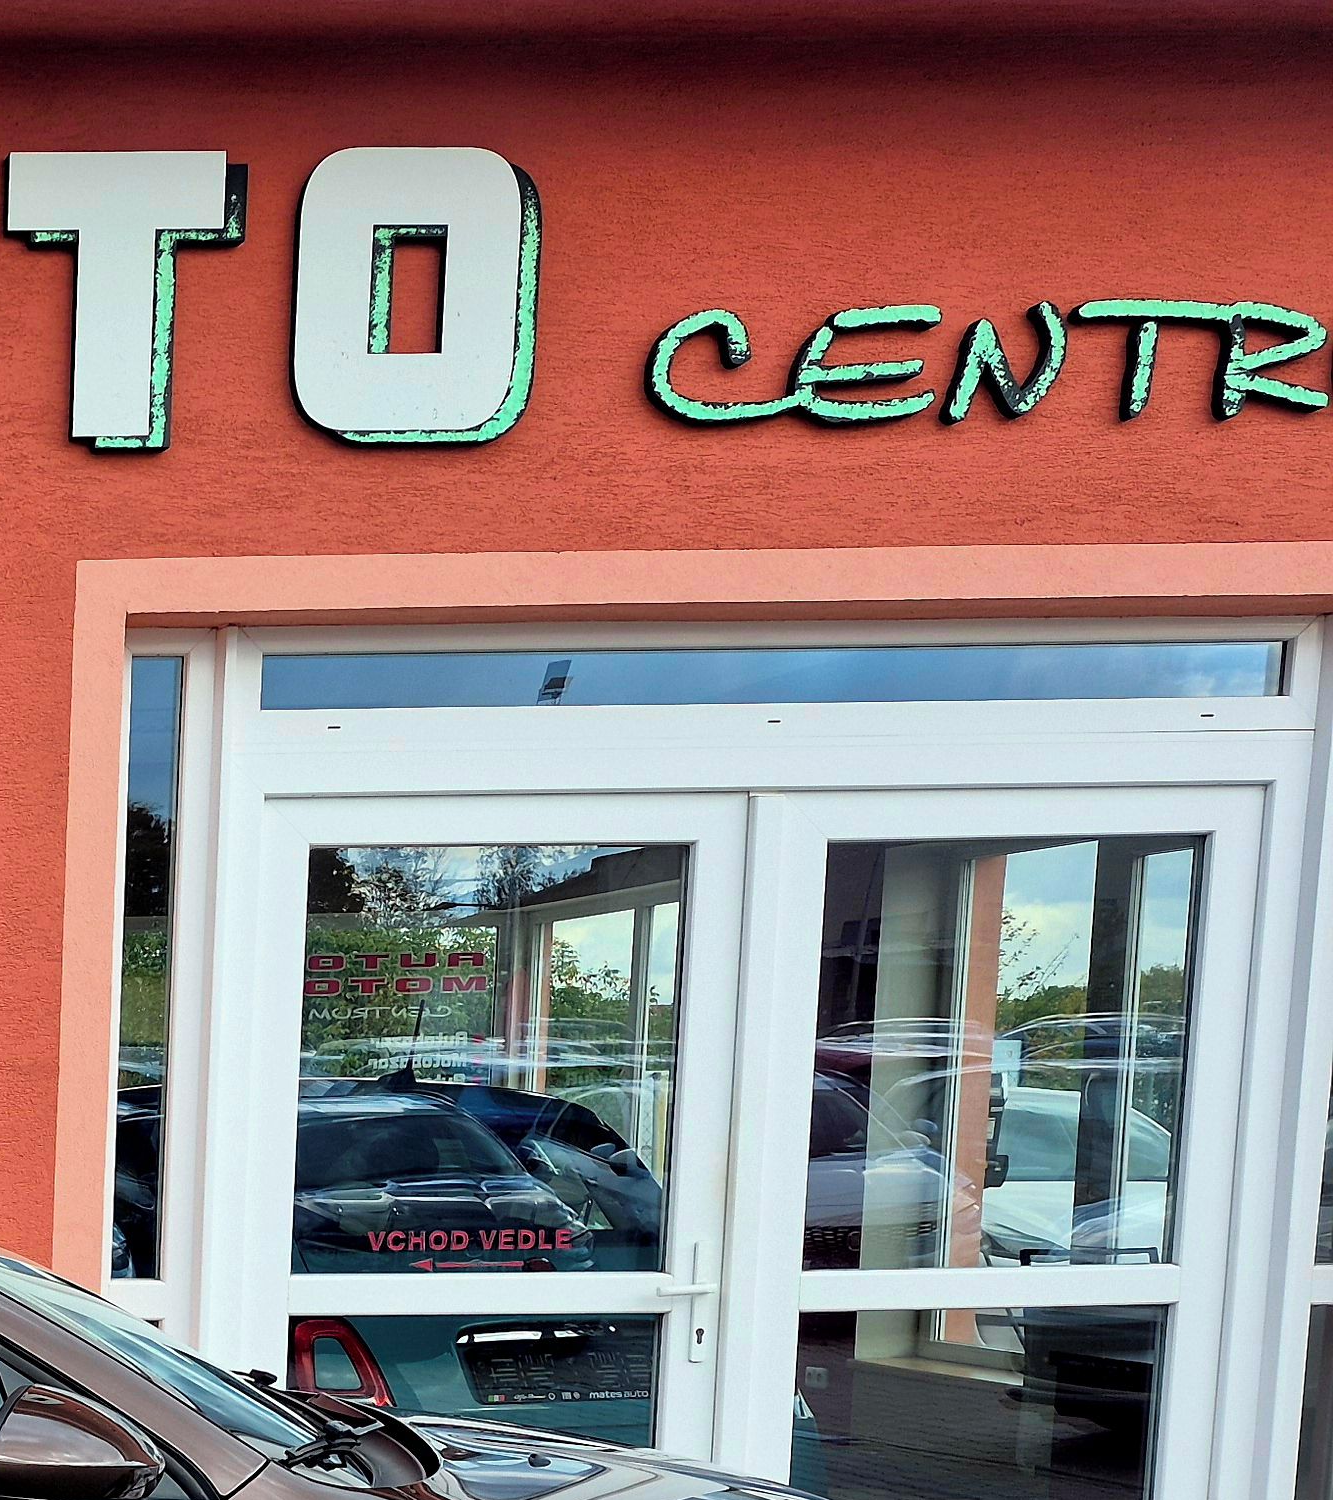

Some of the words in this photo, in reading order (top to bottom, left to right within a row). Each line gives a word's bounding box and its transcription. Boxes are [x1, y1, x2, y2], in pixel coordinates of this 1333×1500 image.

[644, 299, 1333, 427] CENTR
[367, 1230, 469, 1253] VCHOD
[479, 1229, 575, 1251] VEDLE
[623, 1389, 649, 1398] auto
